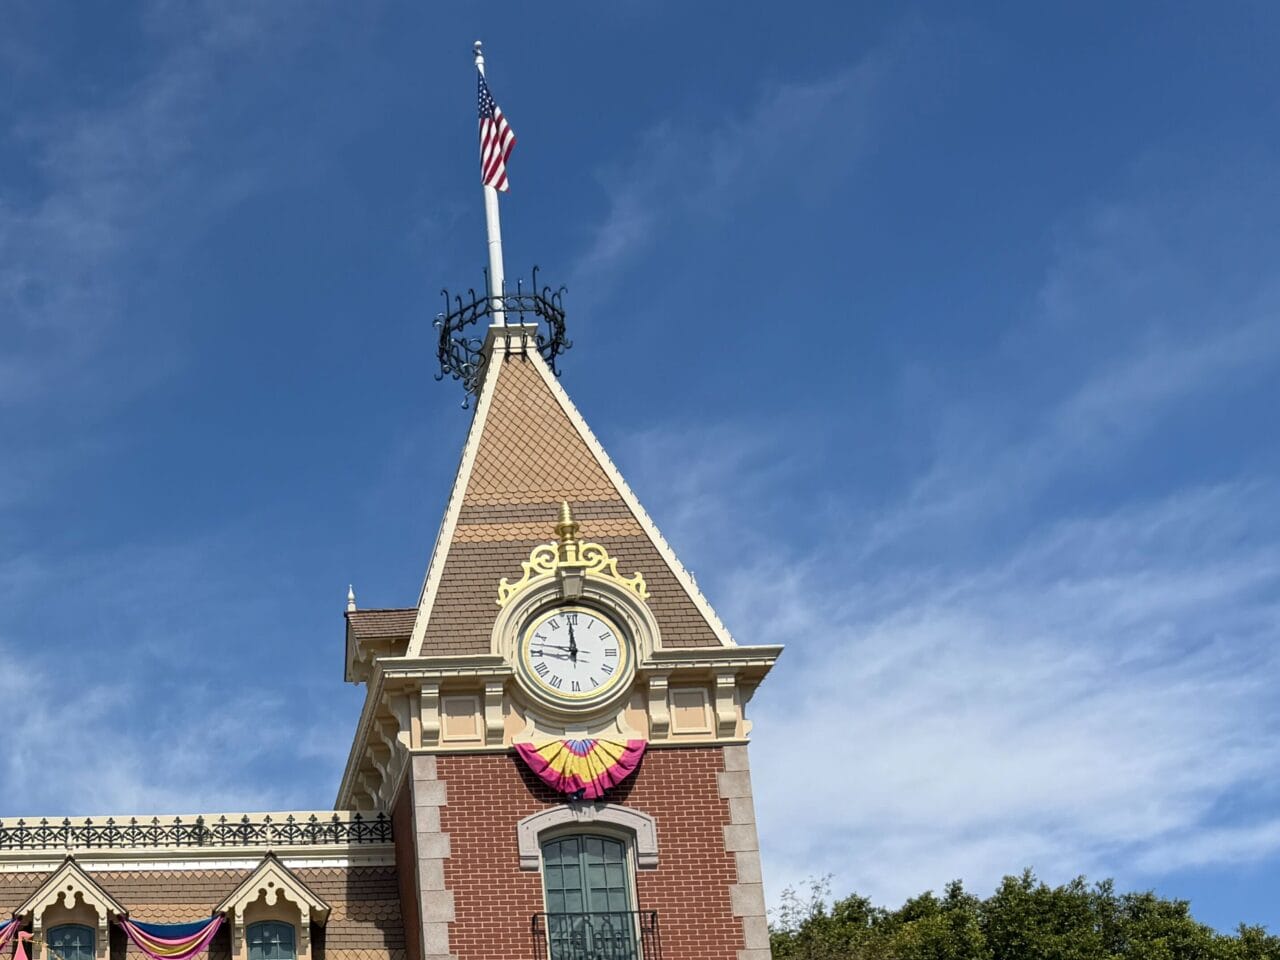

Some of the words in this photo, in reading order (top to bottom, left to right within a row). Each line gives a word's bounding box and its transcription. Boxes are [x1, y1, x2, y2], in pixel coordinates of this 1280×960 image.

[547, 618, 560, 631] XI
[566, 614, 578, 625] XII
[587, 619, 594, 629] I
[535, 632, 547, 641] X
[599, 631, 611, 641] II
[604, 648, 617, 657] III
[549, 675, 563, 689] VII
[571, 680, 581, 692] VI
[590, 677, 599, 688] V
